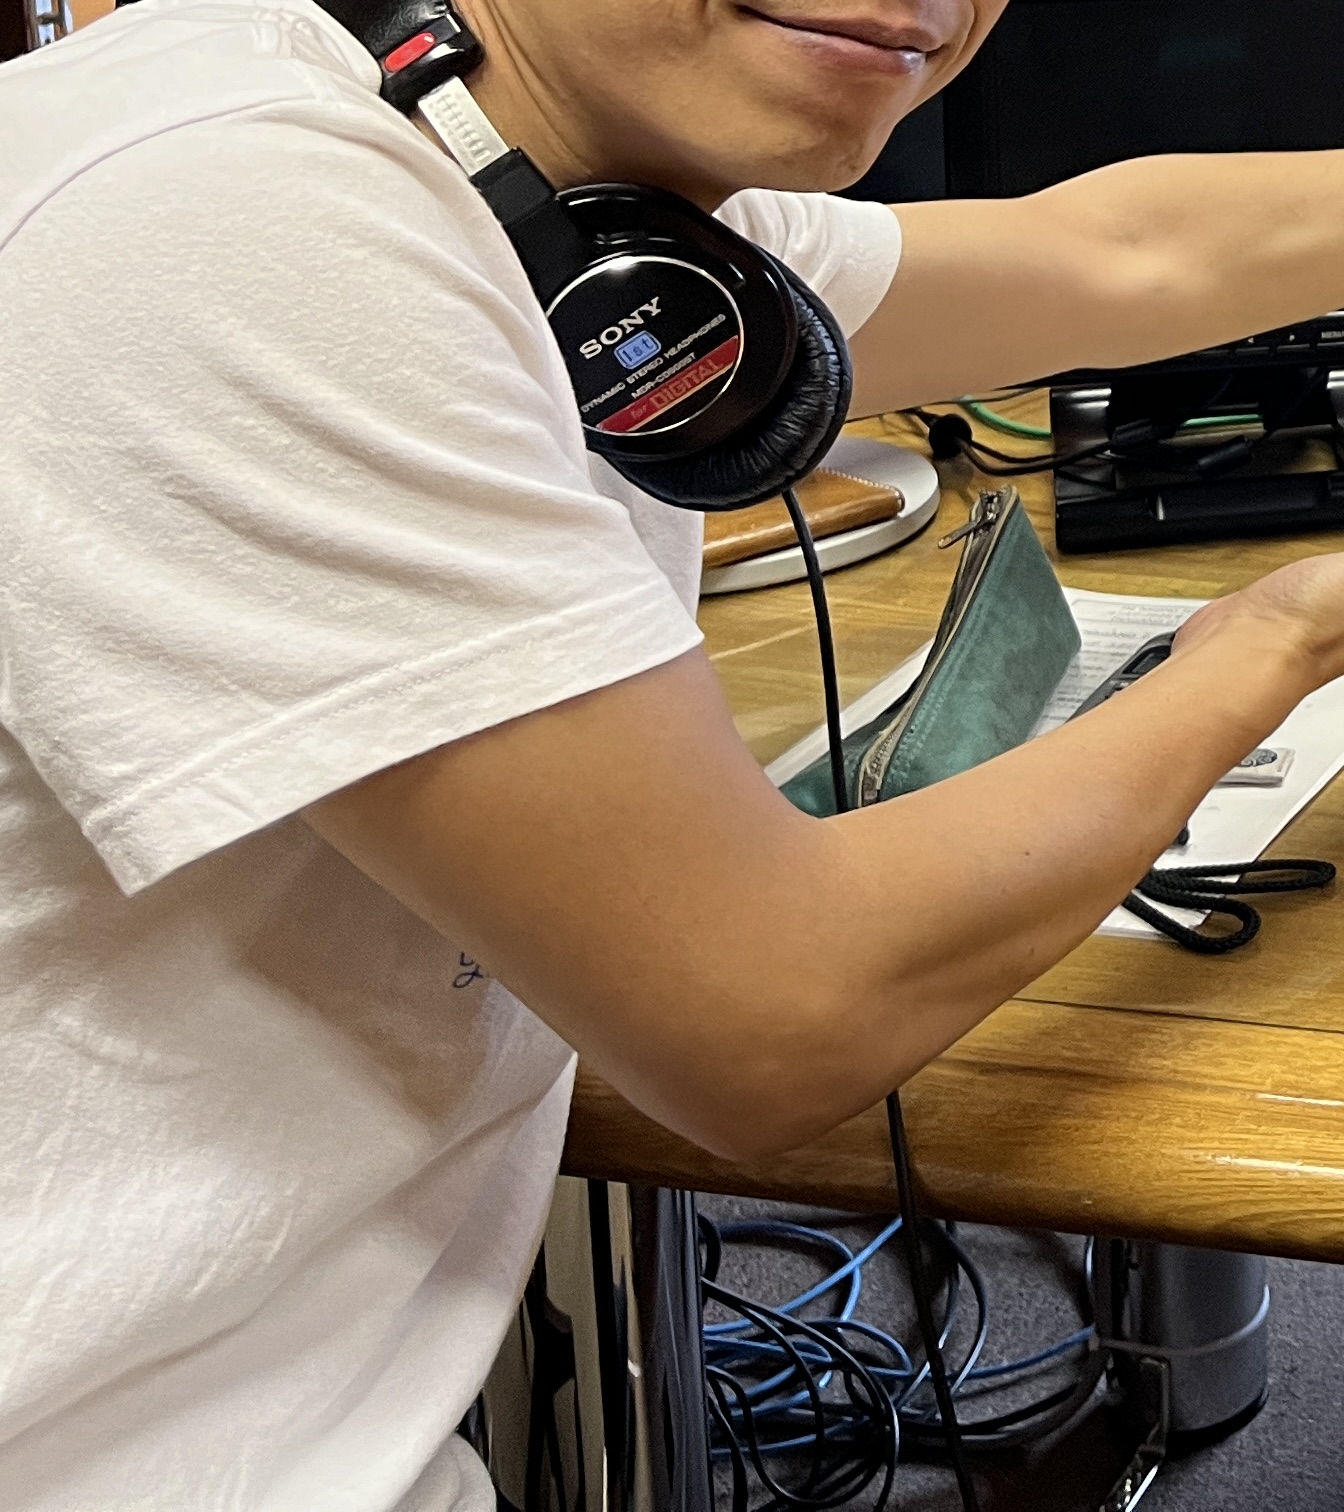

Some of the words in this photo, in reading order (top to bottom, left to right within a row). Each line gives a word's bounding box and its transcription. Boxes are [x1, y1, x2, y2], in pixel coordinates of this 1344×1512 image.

[579, 296, 662, 360] SONY
[580, 381, 626, 413] DYNAMIC
[626, 357, 663, 385] STEREO
[650, 359, 724, 410] DIGITAL
